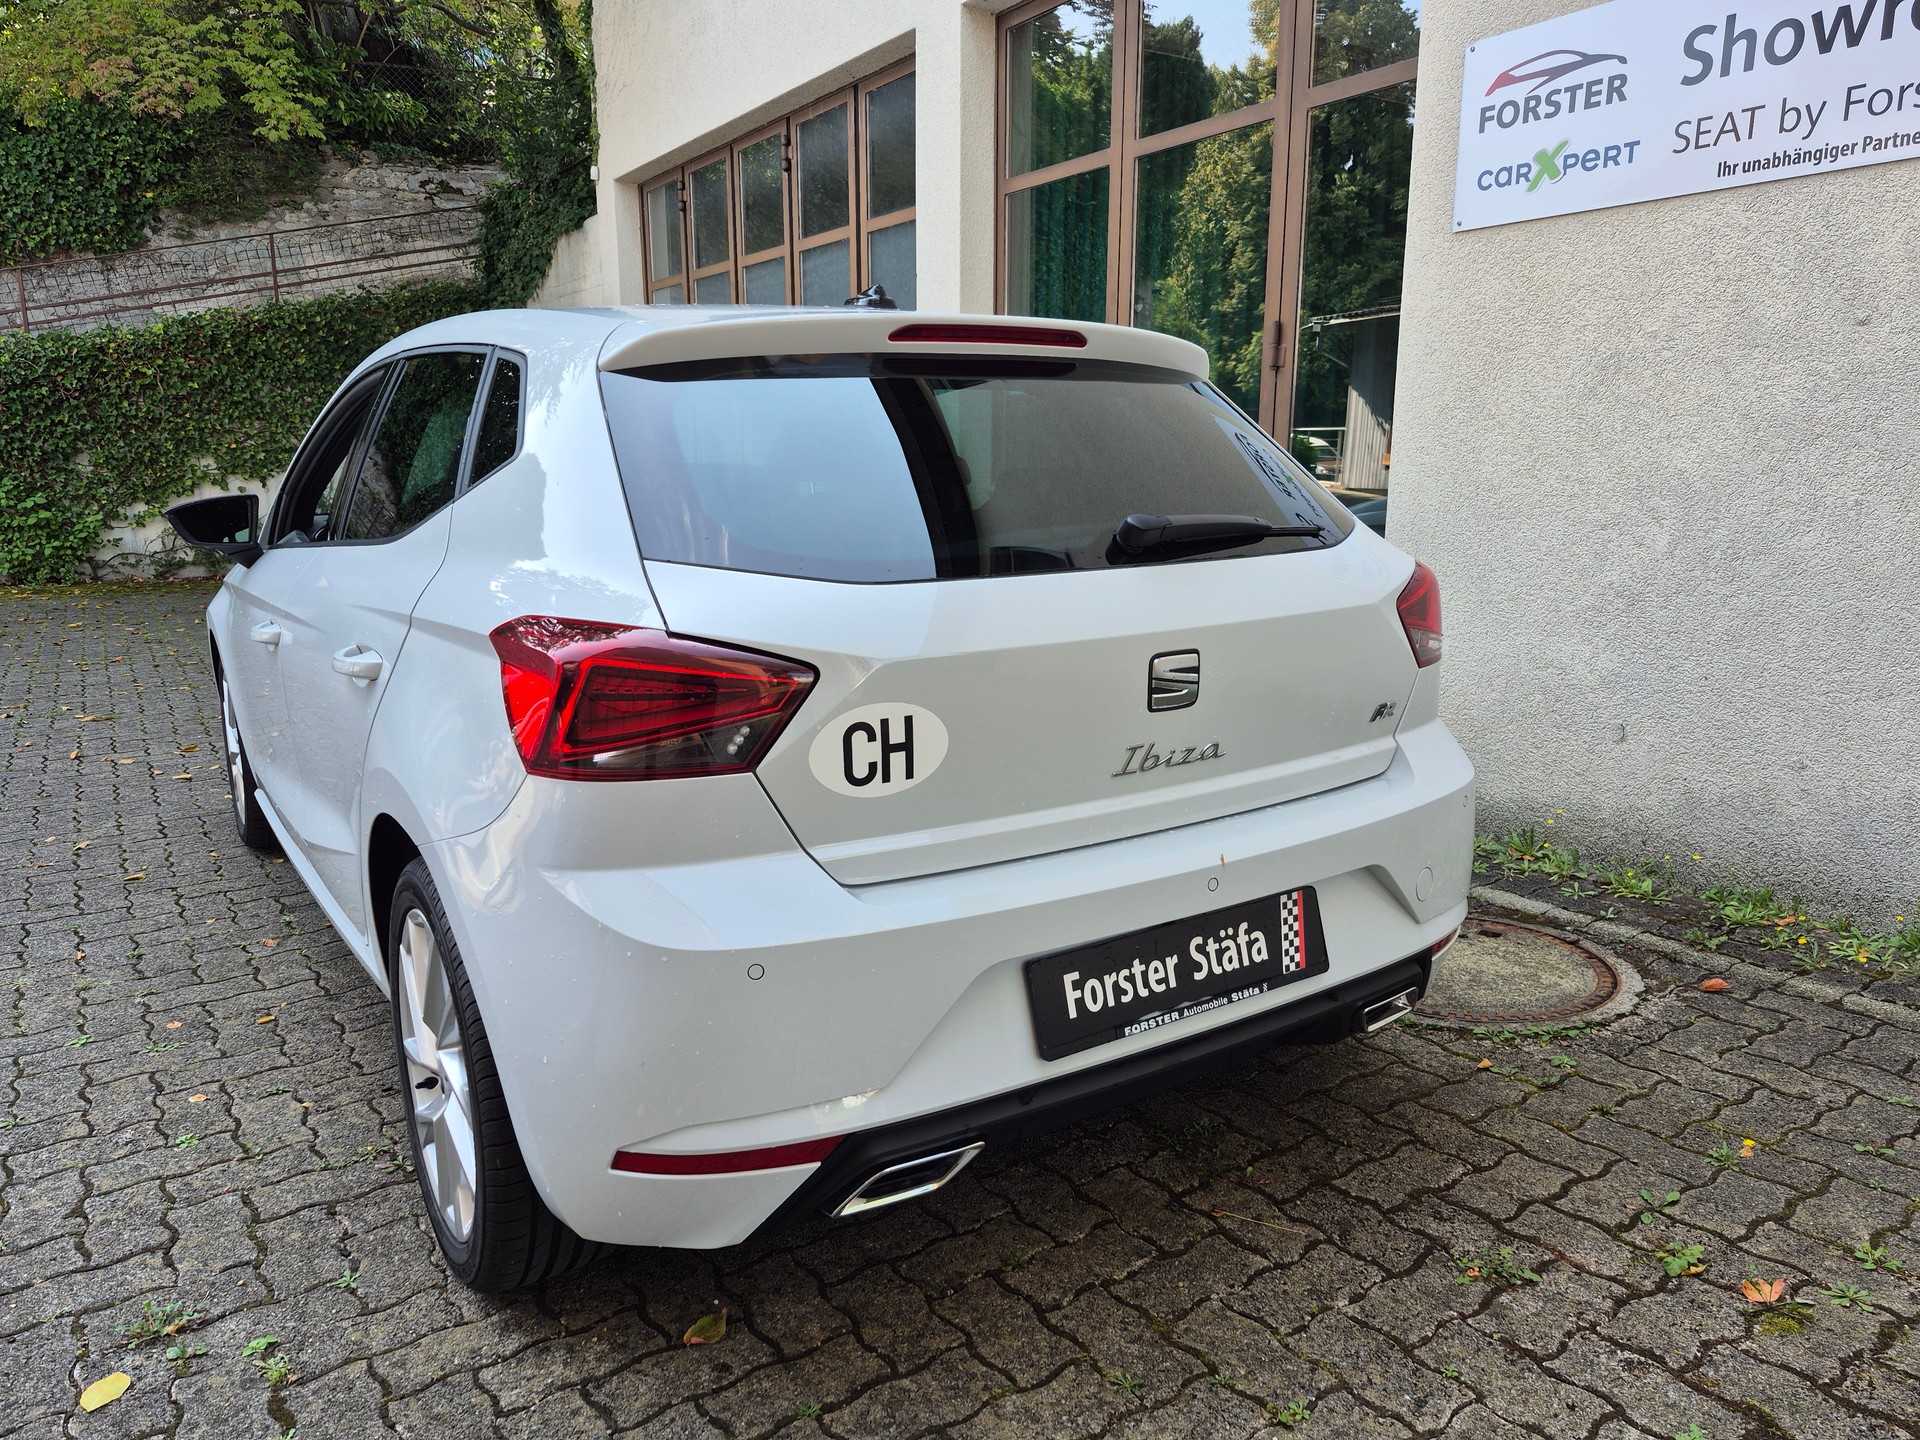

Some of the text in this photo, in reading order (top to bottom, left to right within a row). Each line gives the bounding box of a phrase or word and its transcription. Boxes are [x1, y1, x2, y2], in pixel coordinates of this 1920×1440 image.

[1680, 0, 1920, 86] Showr
[1479, 73, 1628, 134] FORSTER
[1672, 104, 1766, 154] SEAT
[1778, 97, 1827, 140] by
[1717, 161, 1738, 177] Ihr
[1742, 142, 1858, 173] unabhängiger
[842, 714, 914, 787] CH
[1111, 742, 1227, 778] Ibiza
[1063, 922, 1268, 1019] Forster Stäfa
[1124, 986, 1260, 1037] FORSTER Automobile Stäfa
